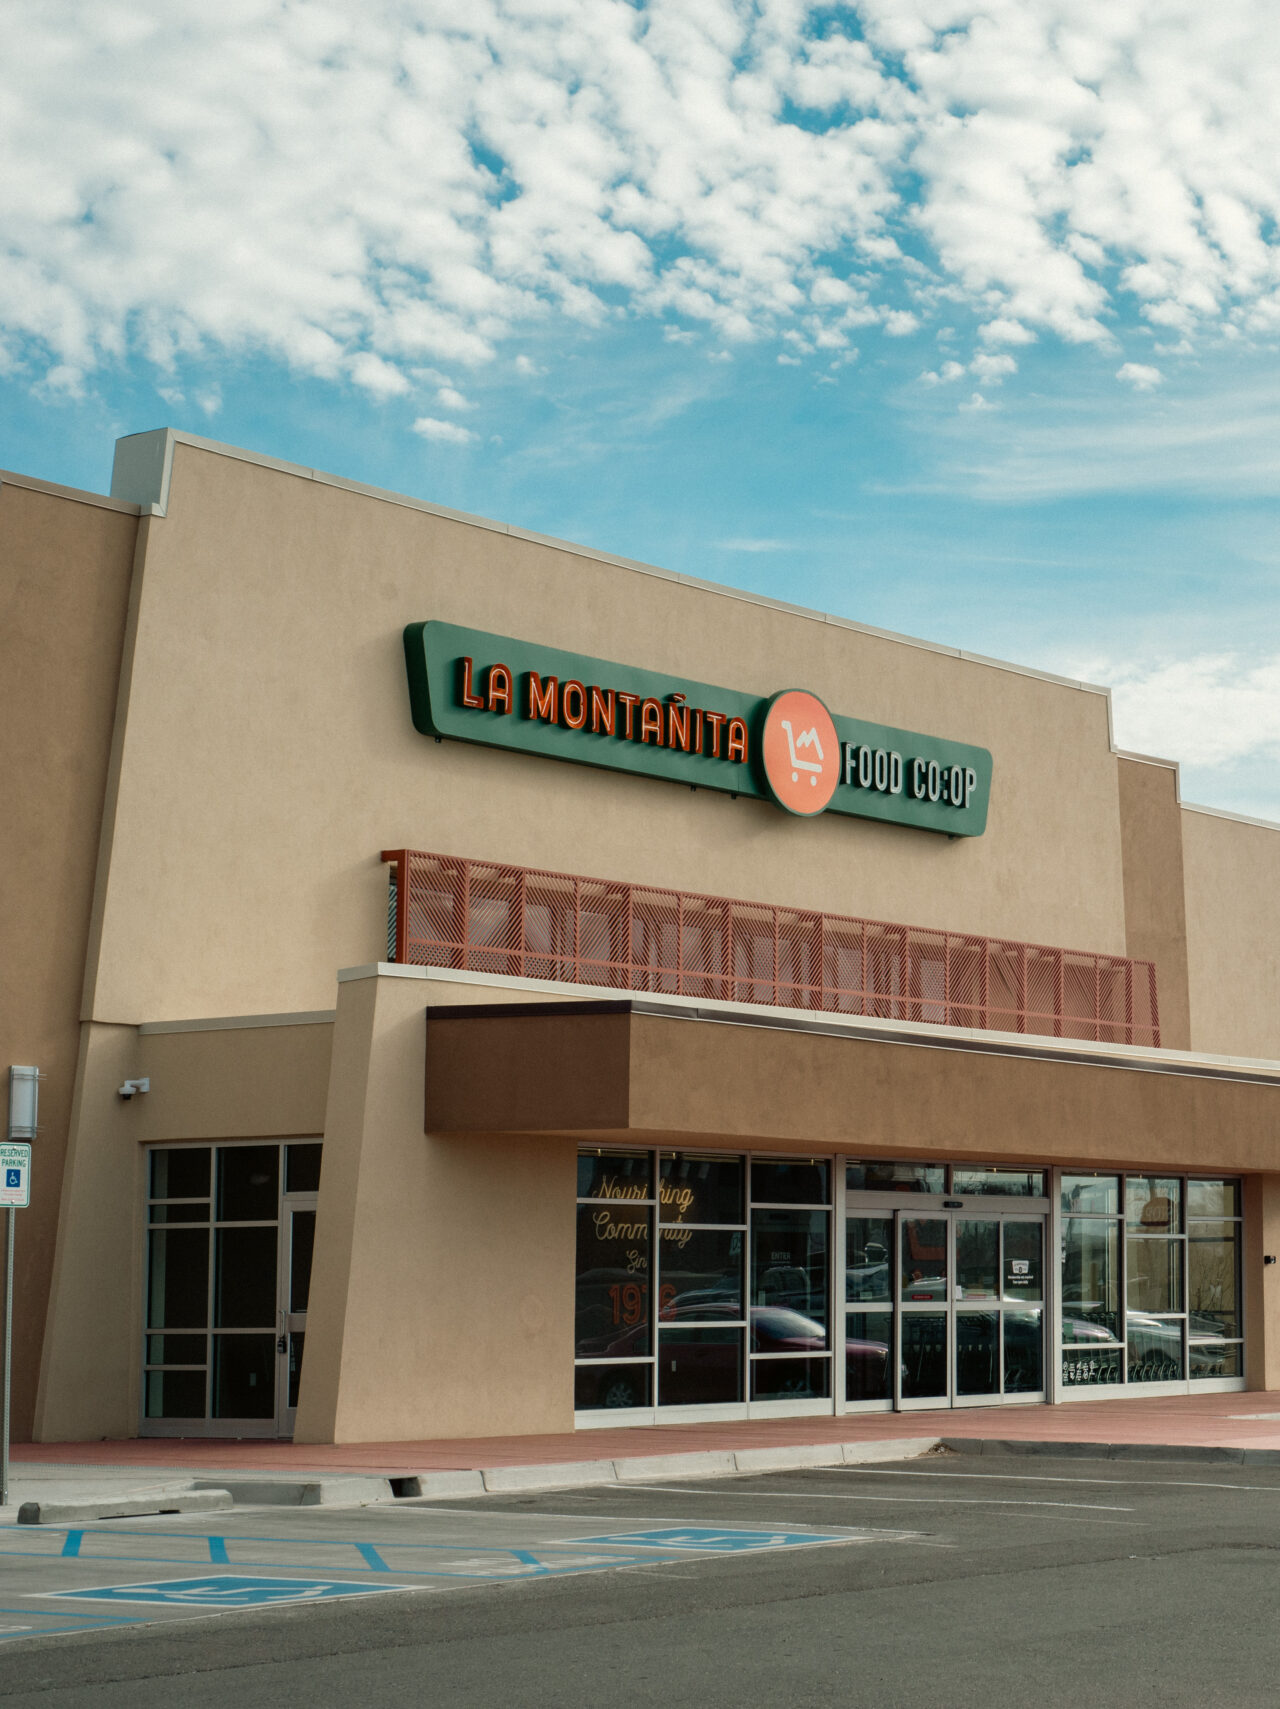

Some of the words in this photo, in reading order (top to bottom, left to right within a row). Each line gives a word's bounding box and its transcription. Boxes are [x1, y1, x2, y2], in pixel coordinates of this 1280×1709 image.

[463, 656, 513, 714] LA
[528, 671, 748, 763] MONTAÑITA
[844, 740, 903, 794] FOOD
[0, 1149, 28, 1158] RESERVED
[1, 1159, 27, 1167] PARKING
[592, 1174, 694, 1212] Nourihing
[592, 1212, 693, 1249] Commnity
[626, 1249, 648, 1274] Sin
